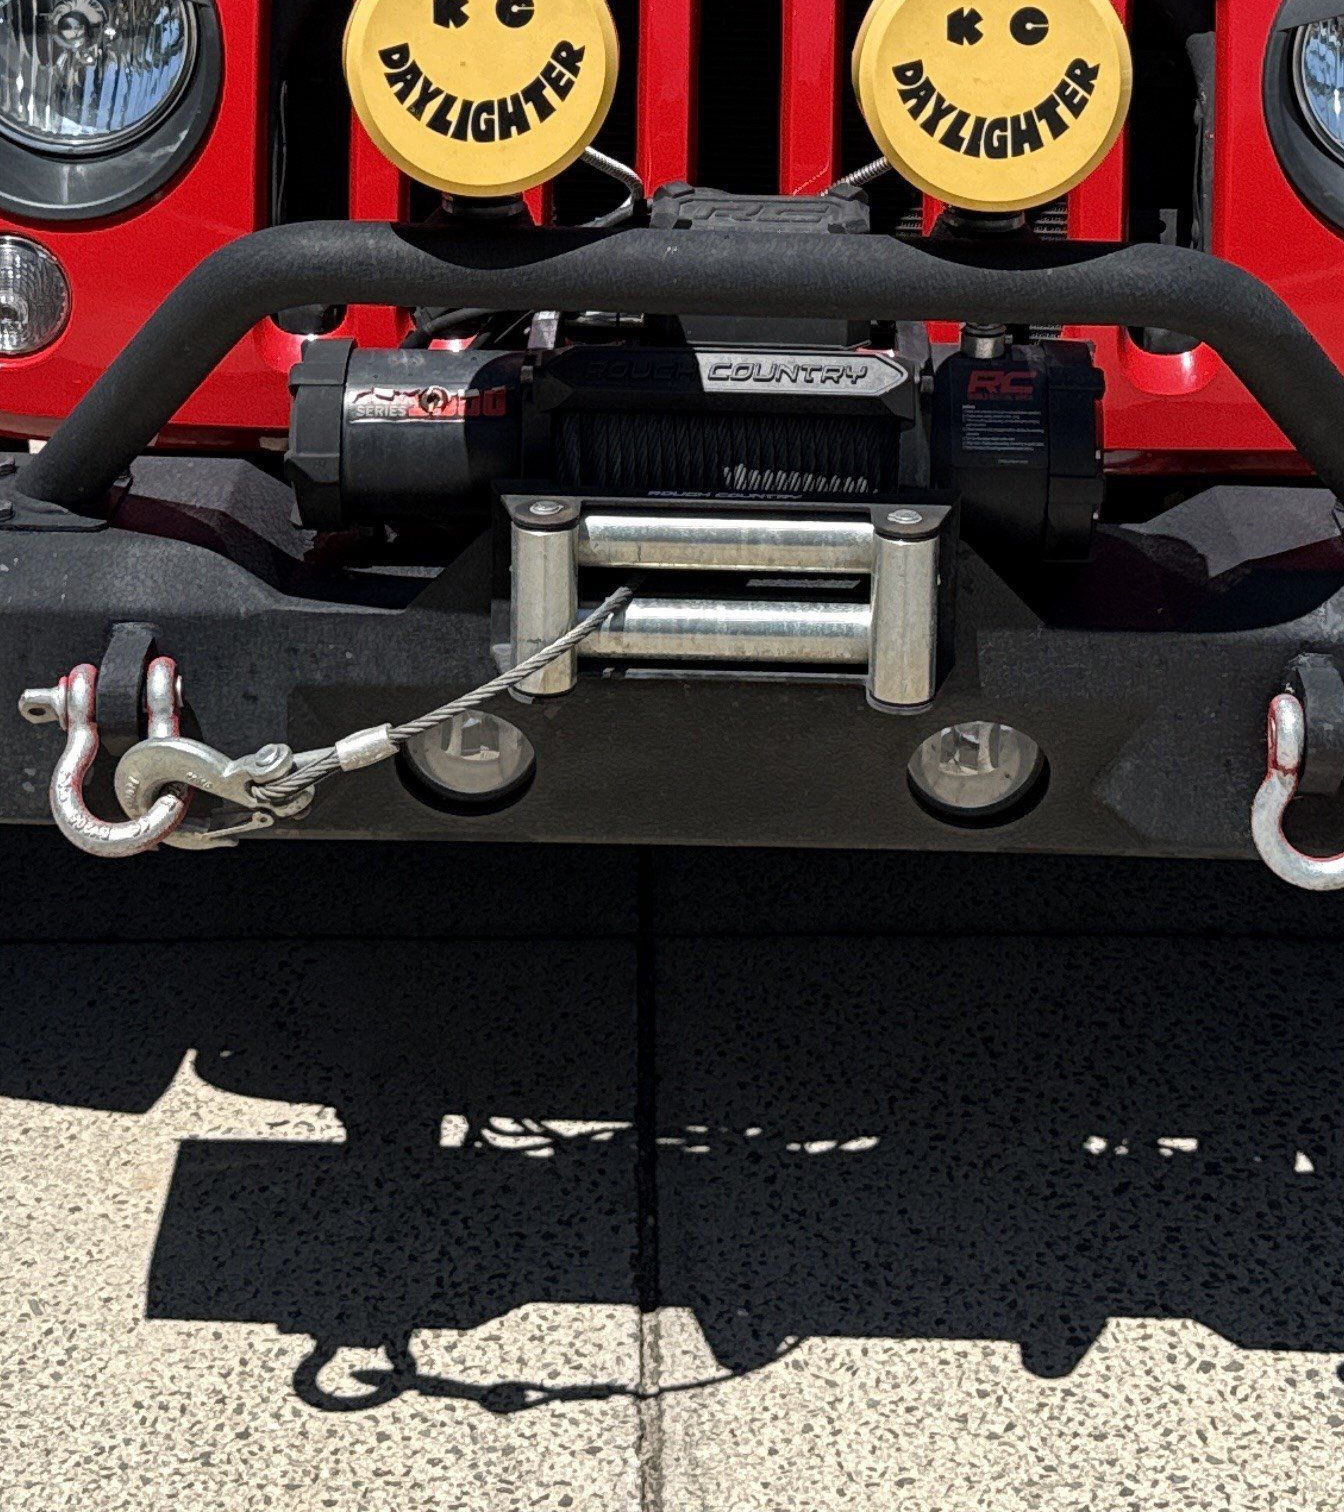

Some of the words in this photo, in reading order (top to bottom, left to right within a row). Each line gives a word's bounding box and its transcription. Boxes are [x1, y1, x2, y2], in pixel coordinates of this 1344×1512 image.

[377, 39, 586, 143] DAYLIGHTER
[891, 57, 1102, 159] DAYLIGHTER
[707, 362, 869, 385] COUNTRY
[967, 370, 1037, 394] RC
[355, 404, 407, 417] SERIES
